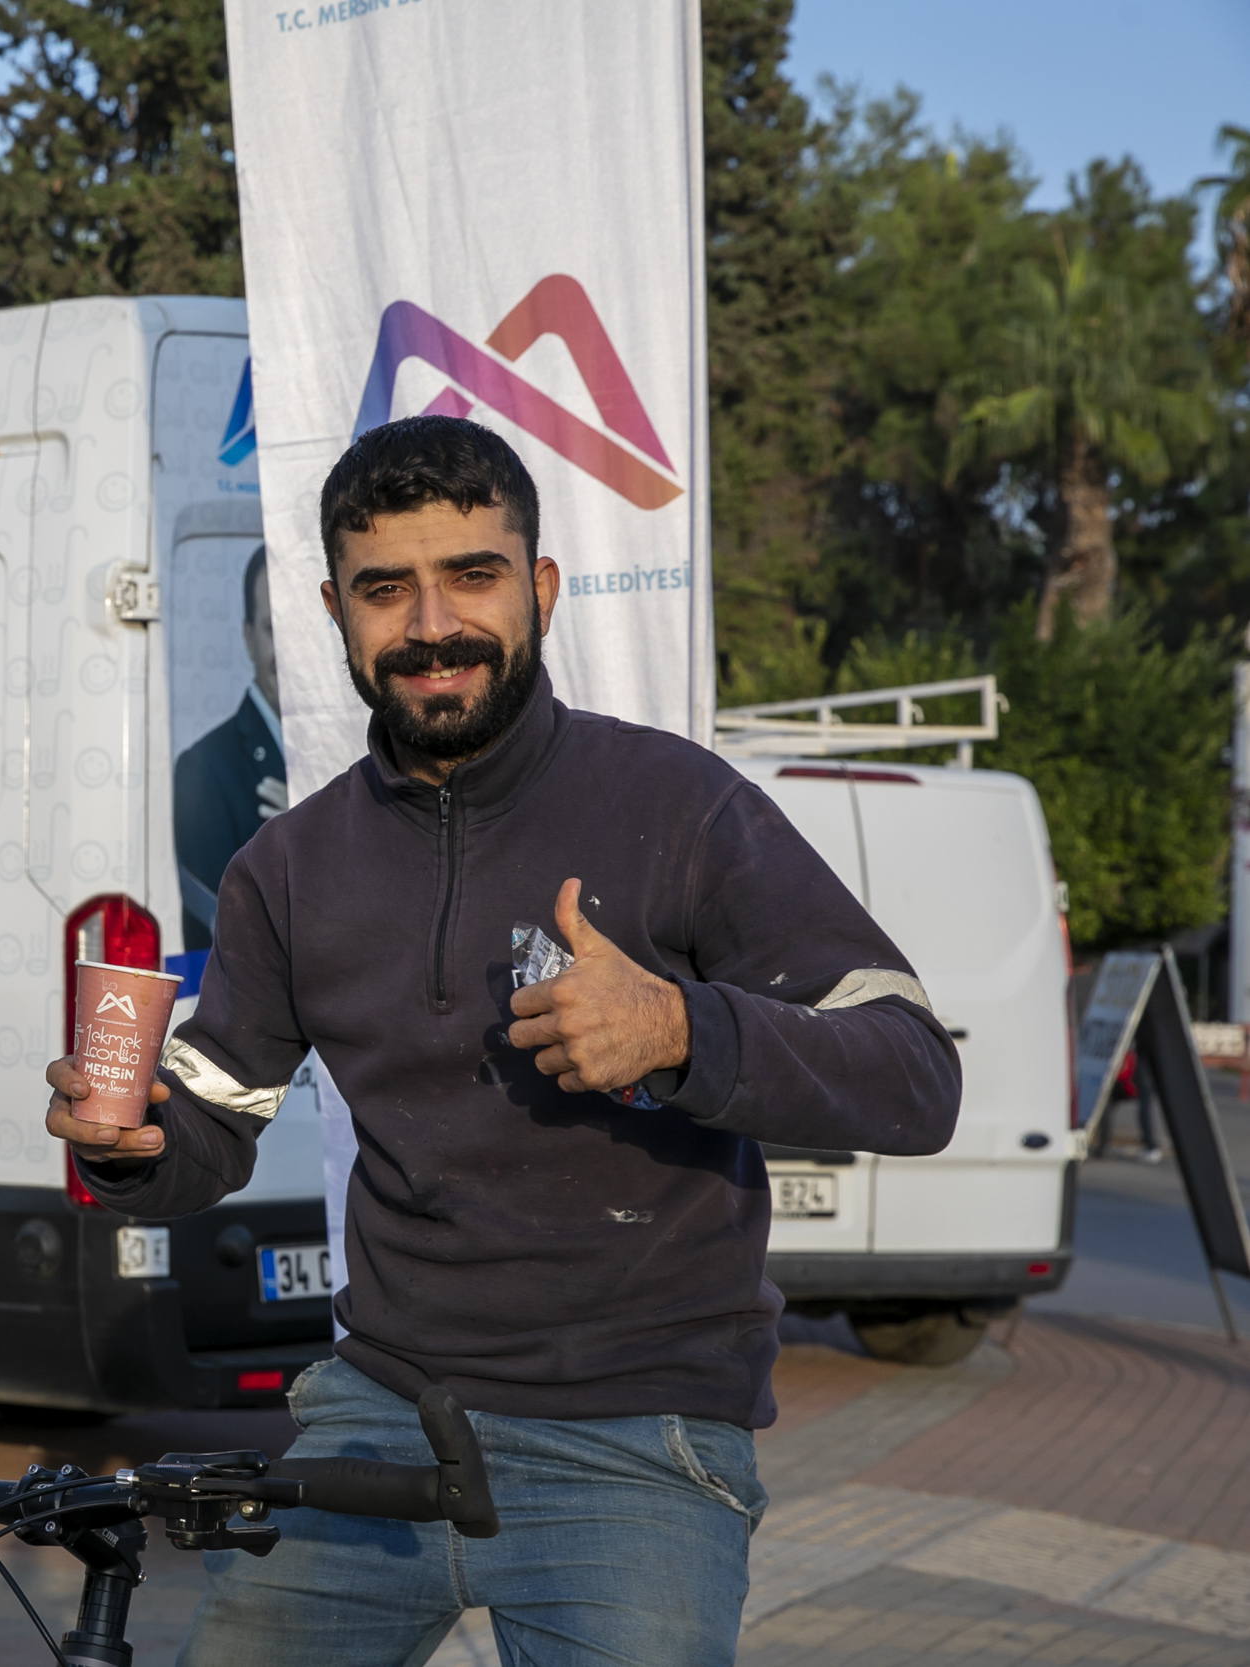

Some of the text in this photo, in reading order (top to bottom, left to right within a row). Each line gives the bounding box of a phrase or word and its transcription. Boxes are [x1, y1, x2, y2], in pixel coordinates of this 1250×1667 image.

[276, 9, 312, 32] T.C.
[568, 560, 691, 598] BELEDİYESİ
[278, 1253, 311, 1293] 34
